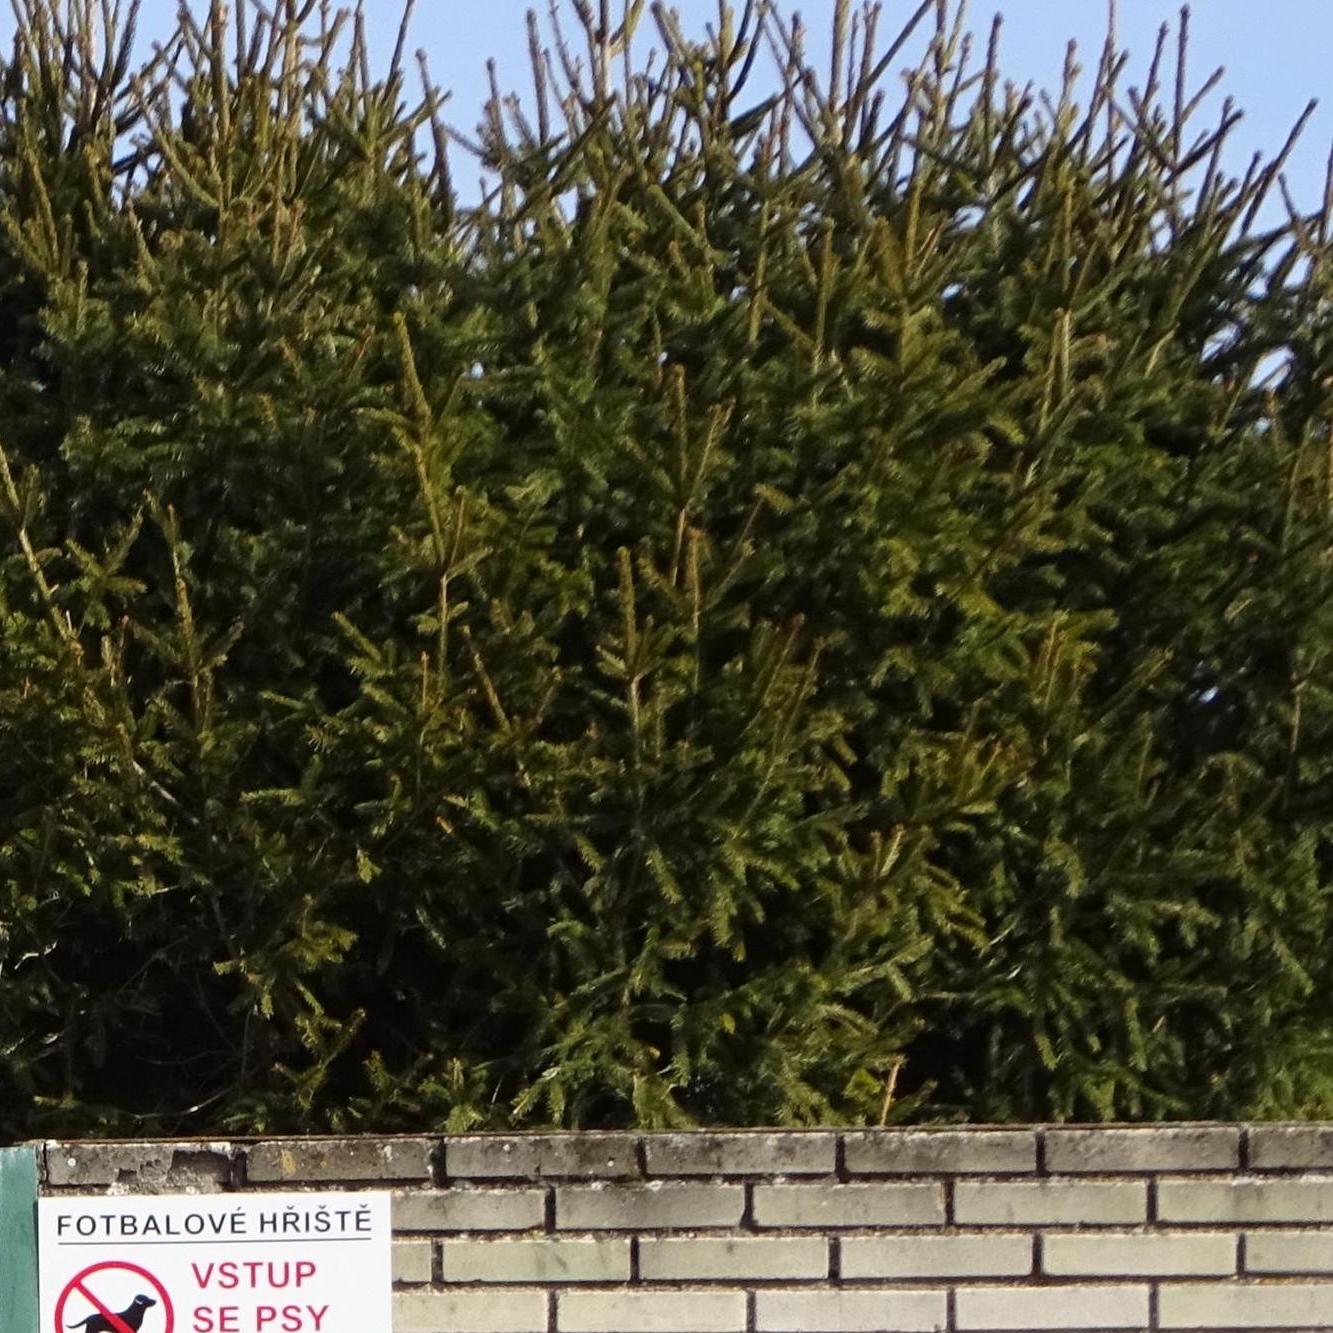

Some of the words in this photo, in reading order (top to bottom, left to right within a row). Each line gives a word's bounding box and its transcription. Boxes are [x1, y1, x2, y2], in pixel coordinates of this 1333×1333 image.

[57, 1206, 247, 1236] FOTBALOVÉ
[260, 1203, 372, 1233] HŘIŠTĚ
[191, 1261, 317, 1289] VSTUP
[192, 1306, 240, 1333] SE
[256, 1304, 329, 1332] PSY
